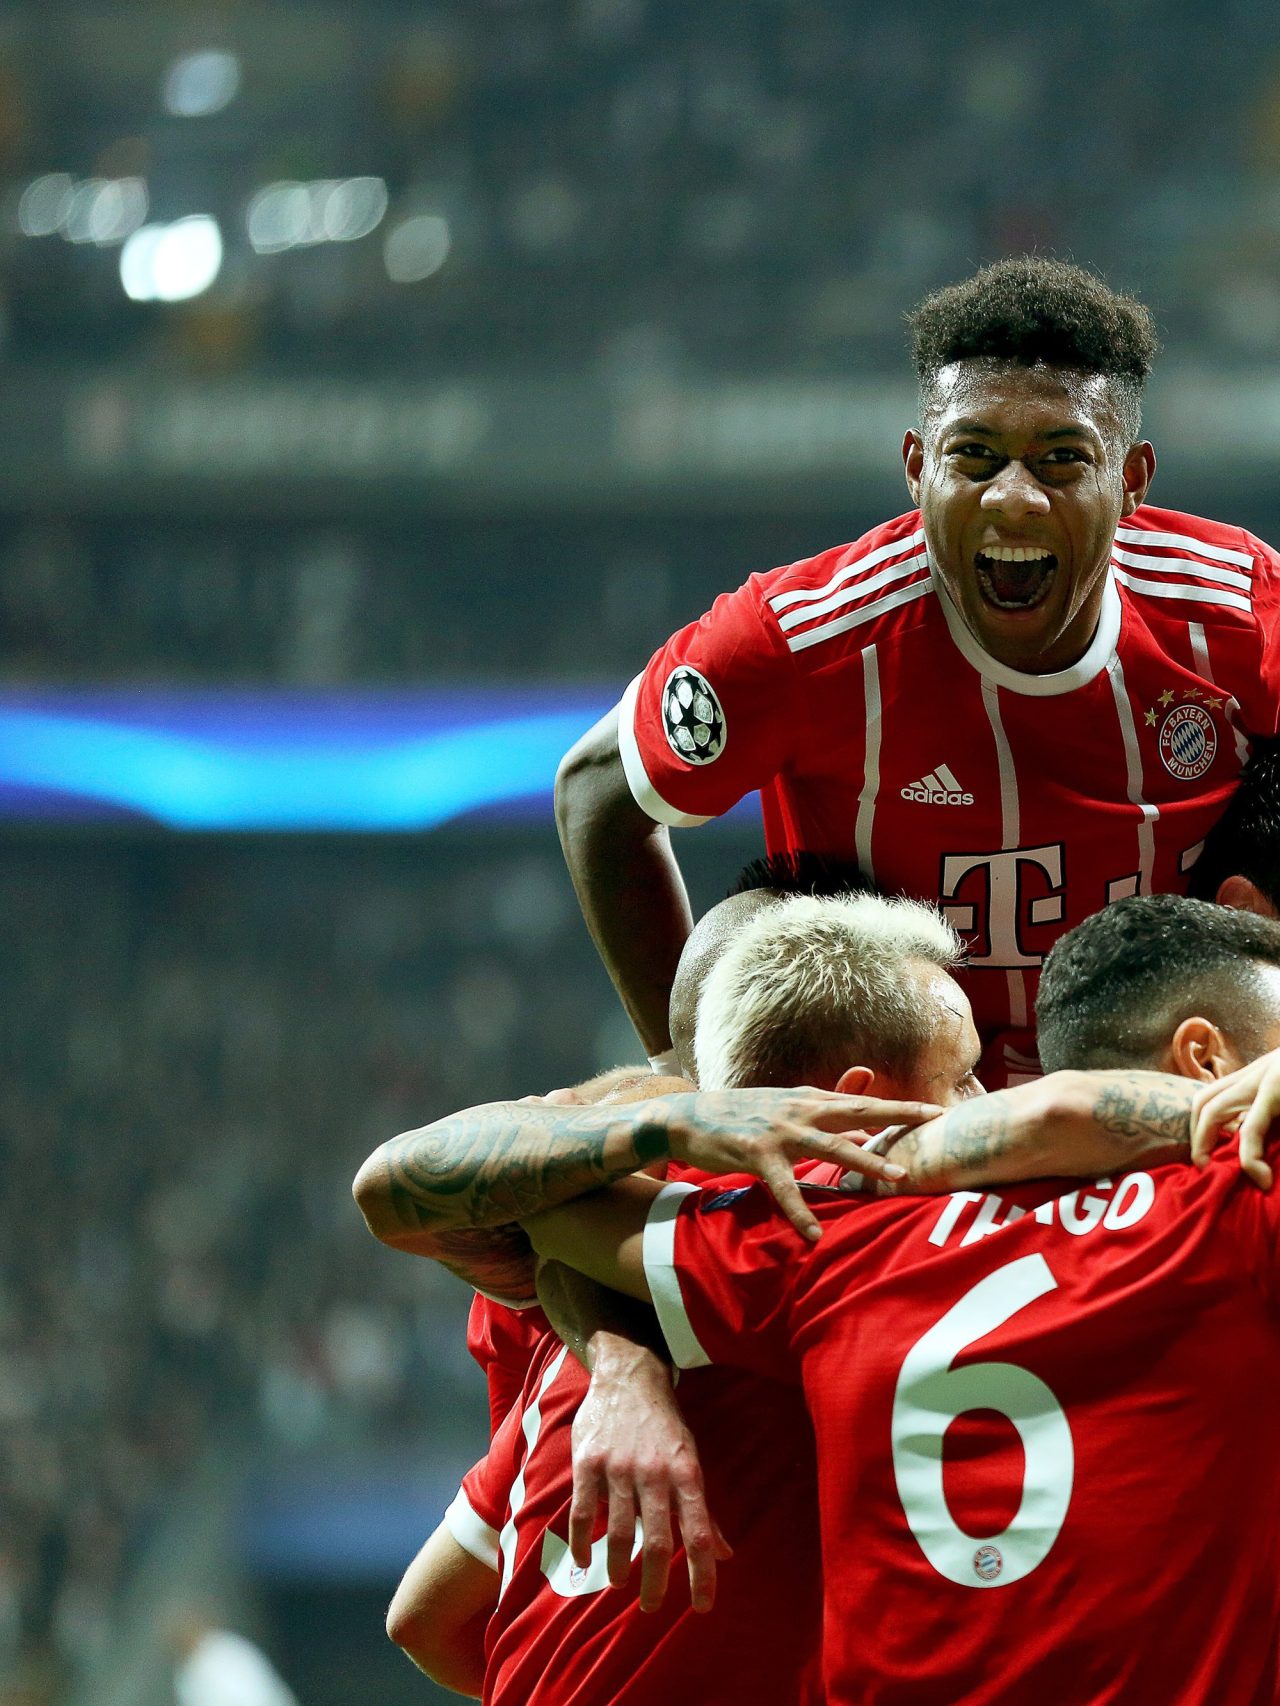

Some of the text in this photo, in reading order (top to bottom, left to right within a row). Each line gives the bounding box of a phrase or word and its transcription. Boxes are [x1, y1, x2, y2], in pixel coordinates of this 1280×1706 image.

[1162, 708, 1210, 747] FC BAYERN
[900, 788, 975, 806] adidas
[891, 1252, 1075, 1589] 6
